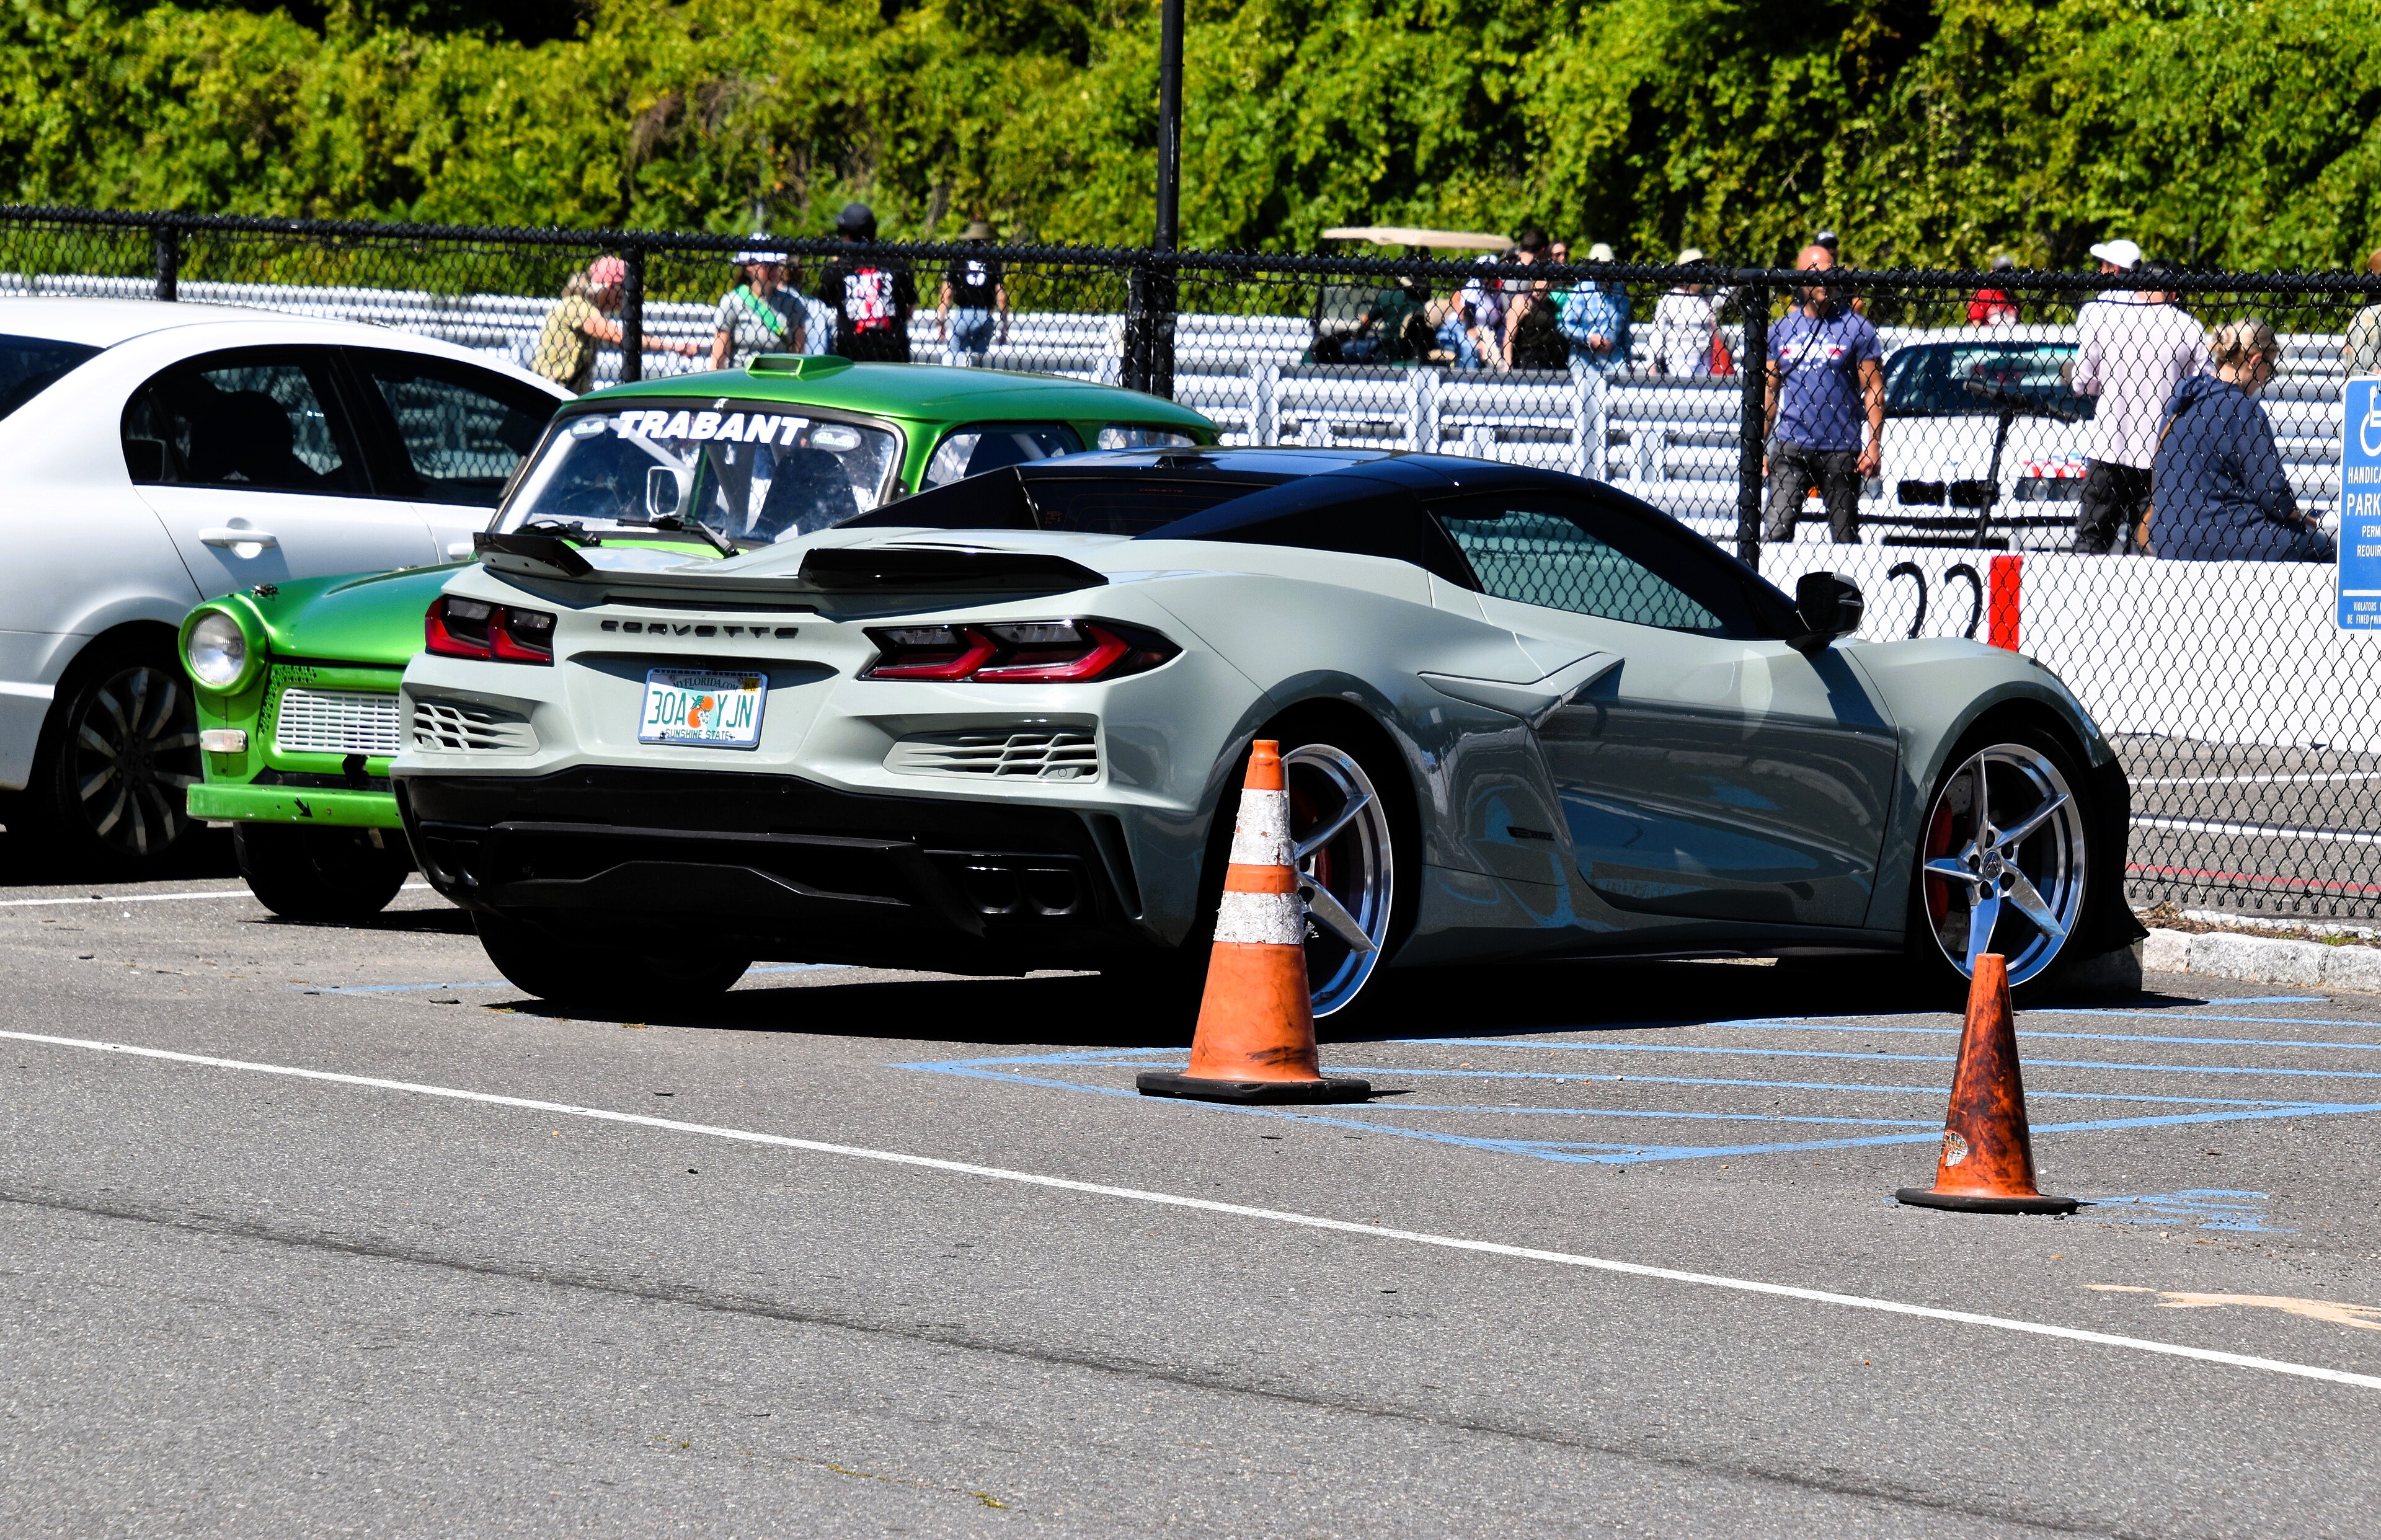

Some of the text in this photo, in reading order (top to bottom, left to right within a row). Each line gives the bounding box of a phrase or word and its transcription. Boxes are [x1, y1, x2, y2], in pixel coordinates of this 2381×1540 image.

[617, 410, 810, 446] TRABANT
[2353, 601, 2377, 611] VIOLATORS
[2347, 614, 2353, 624] BE
[2356, 614, 2369, 624] FINED
[601, 620, 799, 639] CORVETTE
[673, 677, 738, 693] MYFLORIDA.COM
[647, 691, 755, 728] 30A YJN
[665, 728, 730, 740] SUNSHINE STATE
